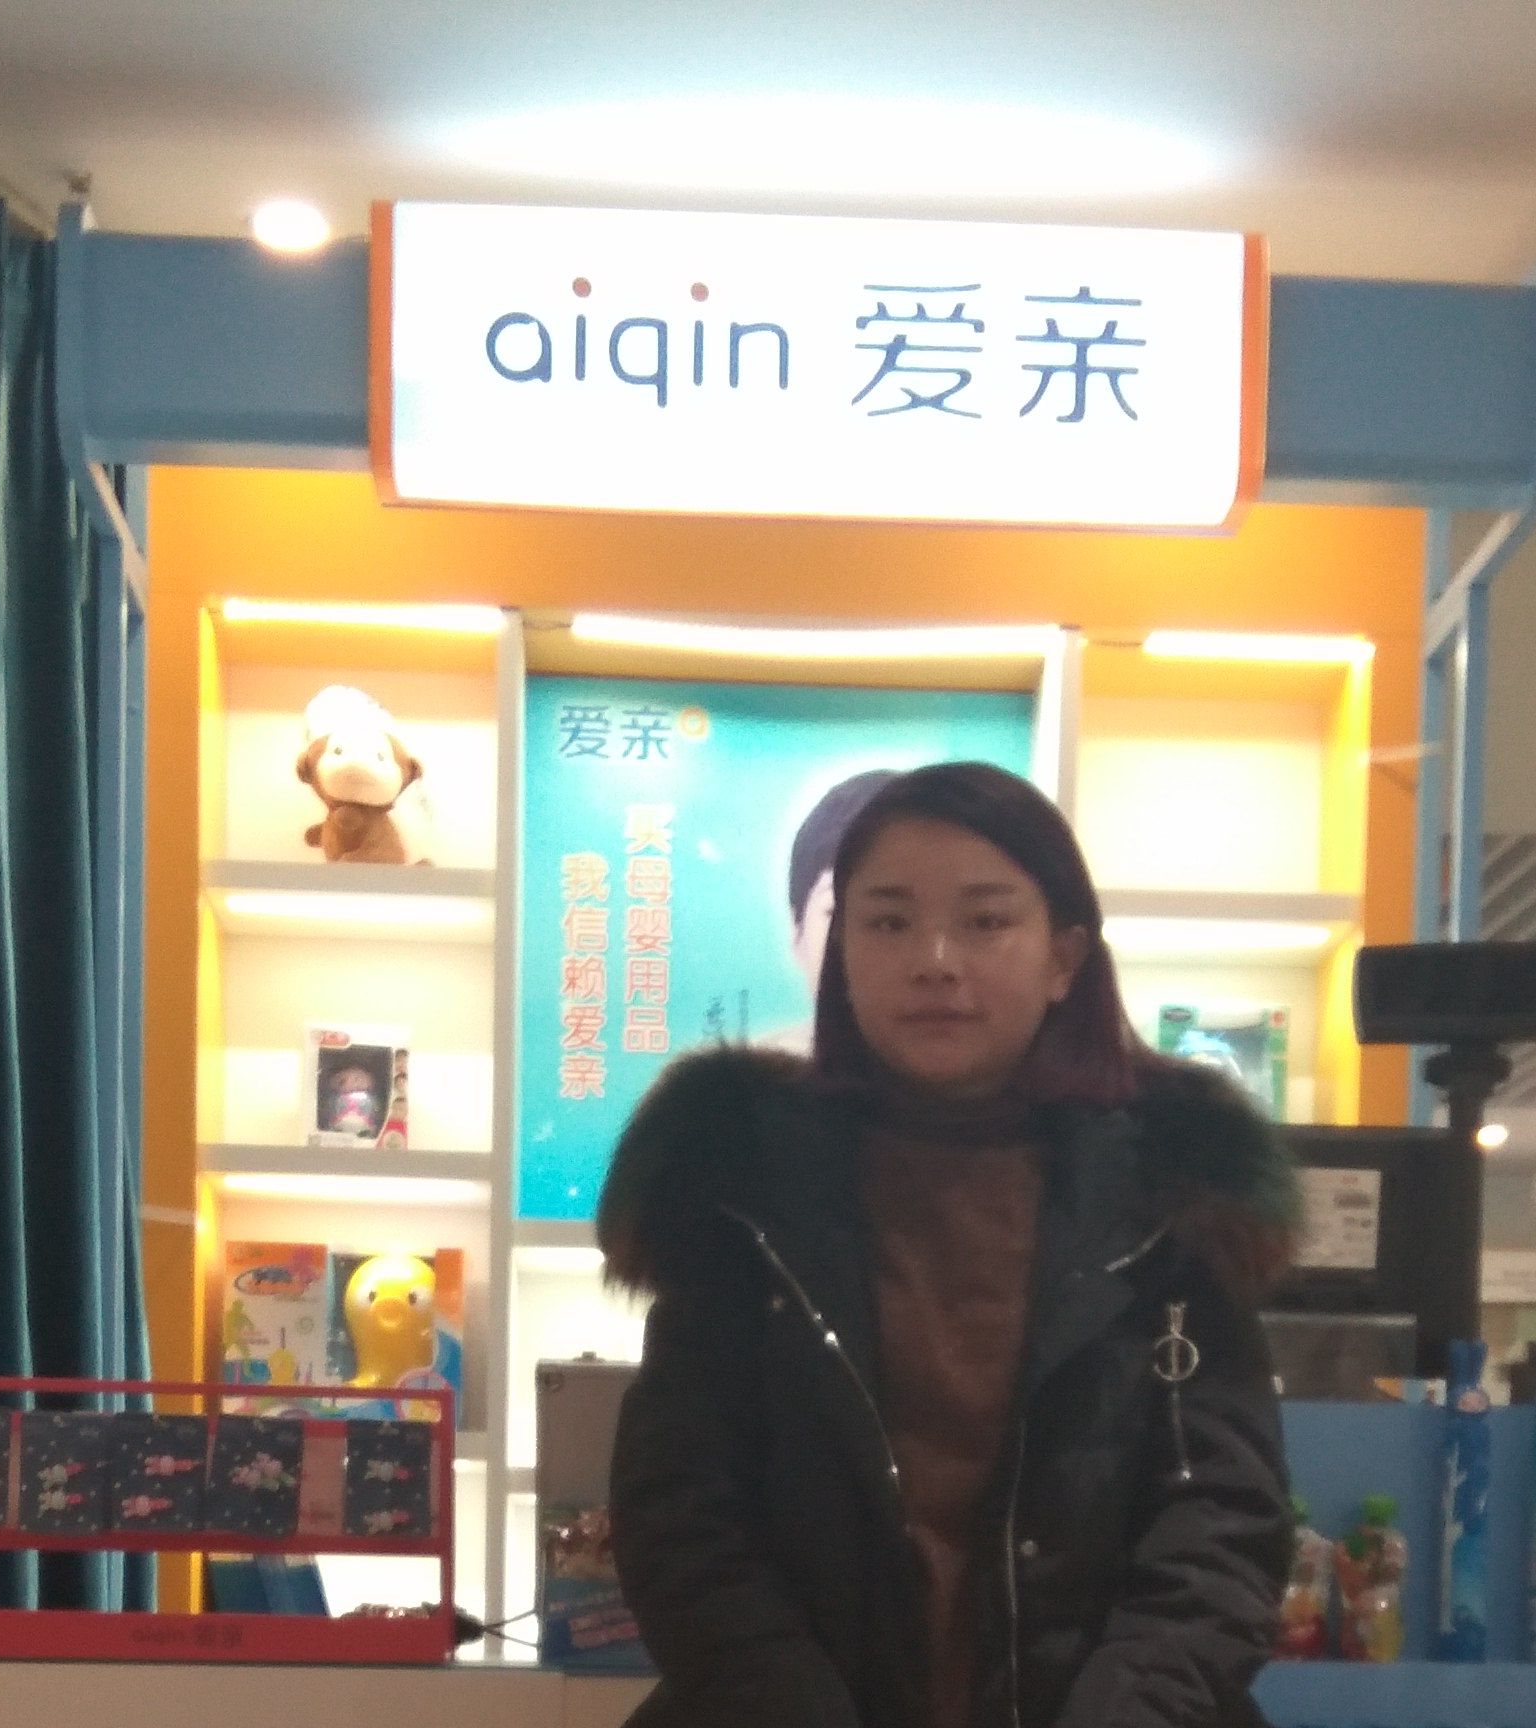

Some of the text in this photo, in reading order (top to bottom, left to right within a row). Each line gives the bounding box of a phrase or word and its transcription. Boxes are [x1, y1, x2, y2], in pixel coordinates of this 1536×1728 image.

[485, 276, 1148, 424] aiqin 爱亲
[559, 704, 672, 760] 爱亲
[560, 852, 609, 1099] 我信赖爱亲
